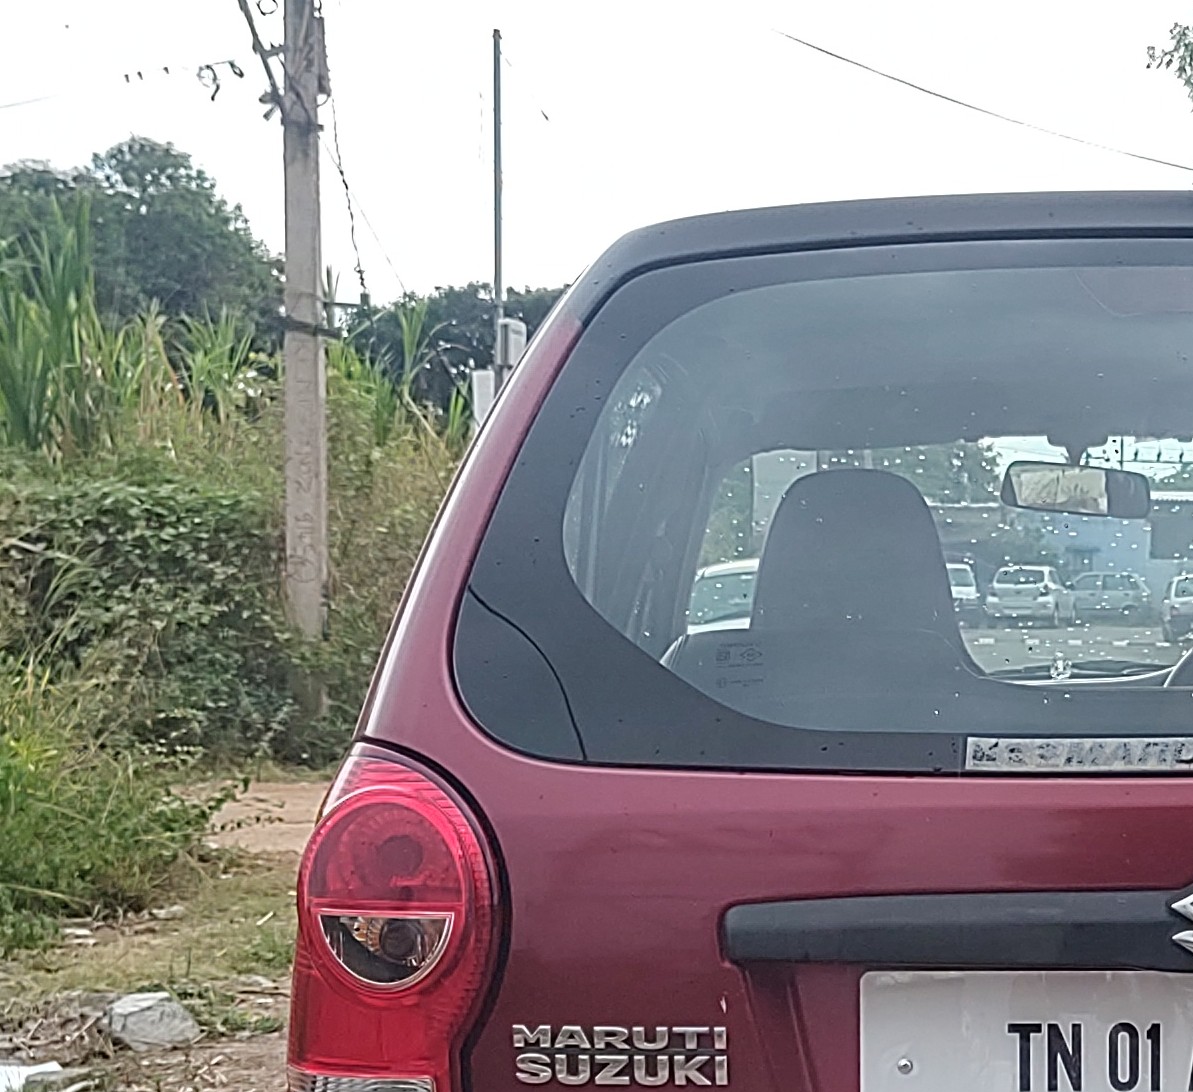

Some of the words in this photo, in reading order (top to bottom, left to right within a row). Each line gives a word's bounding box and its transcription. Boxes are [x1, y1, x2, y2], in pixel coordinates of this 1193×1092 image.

[512, 1024, 727, 1050] MARUTI
[515, 1053, 729, 1086] SUZUKI
[1007, 1022, 1083, 1092] TN
[1108, 1022, 1161, 1092] 01
